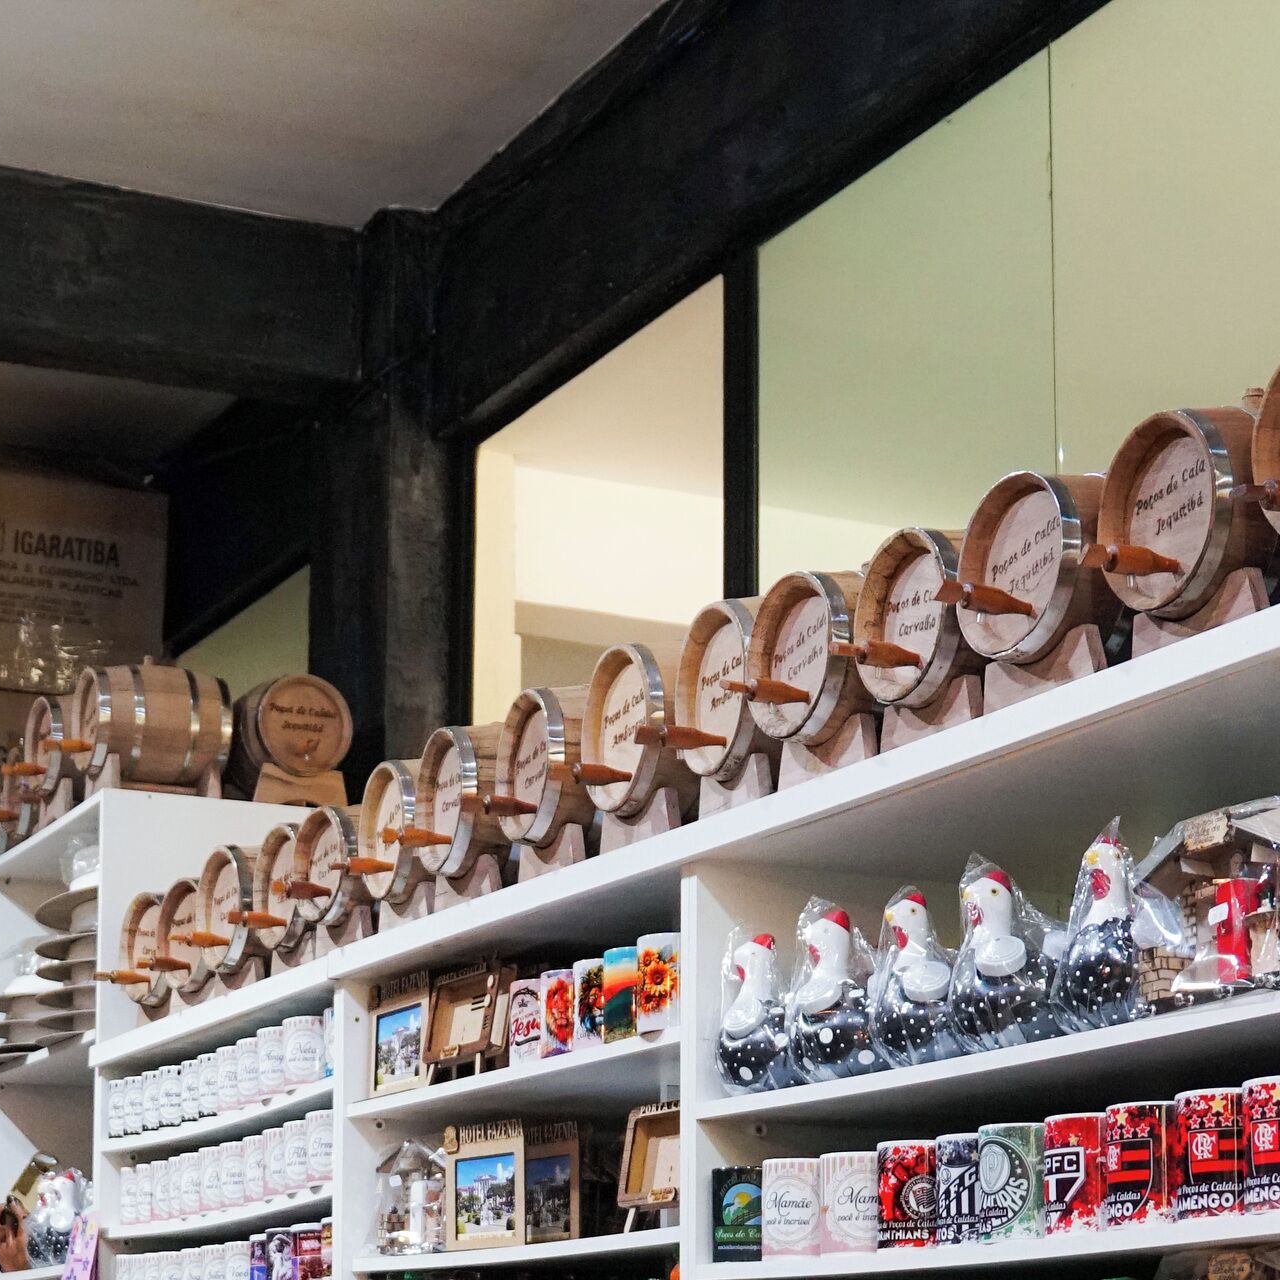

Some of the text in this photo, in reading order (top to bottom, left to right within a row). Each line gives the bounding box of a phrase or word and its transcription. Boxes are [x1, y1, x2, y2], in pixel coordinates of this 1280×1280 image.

[1136, 474, 1179, 515] Poços de
[13, 529, 120, 566] IGARATIBA
[992, 539, 1031, 582] Poços de
[911, 590, 920, 606] de
[898, 616, 937, 637] Carvalho
[774, 632, 806, 669] Poços de
[787, 644, 824, 681] Carvalho
[701, 661, 731, 691] Poços de
[623, 699, 631, 712] de
[510, 1017, 541, 1041] Jesu
[640, 1104, 669, 1115] PORTA
[459, 1119, 524, 1143] HOTEL FAZENDA
[1182, 1181, 1242, 1192] Poços de Caldas
[1262, 1174, 1270, 1184] de
[767, 1191, 812, 1217] Mamãe
[1117, 1192, 1140, 1201] Caldas
[1178, 1193, 1234, 1211] AMENGO
[837, 1214, 854, 1222] você
[954, 1214, 979, 1224] Caldas
[985, 1208, 1006, 1217] Caldas
[908, 1221, 915, 1229] de
[878, 1229, 929, 1241] RINTHIANS
